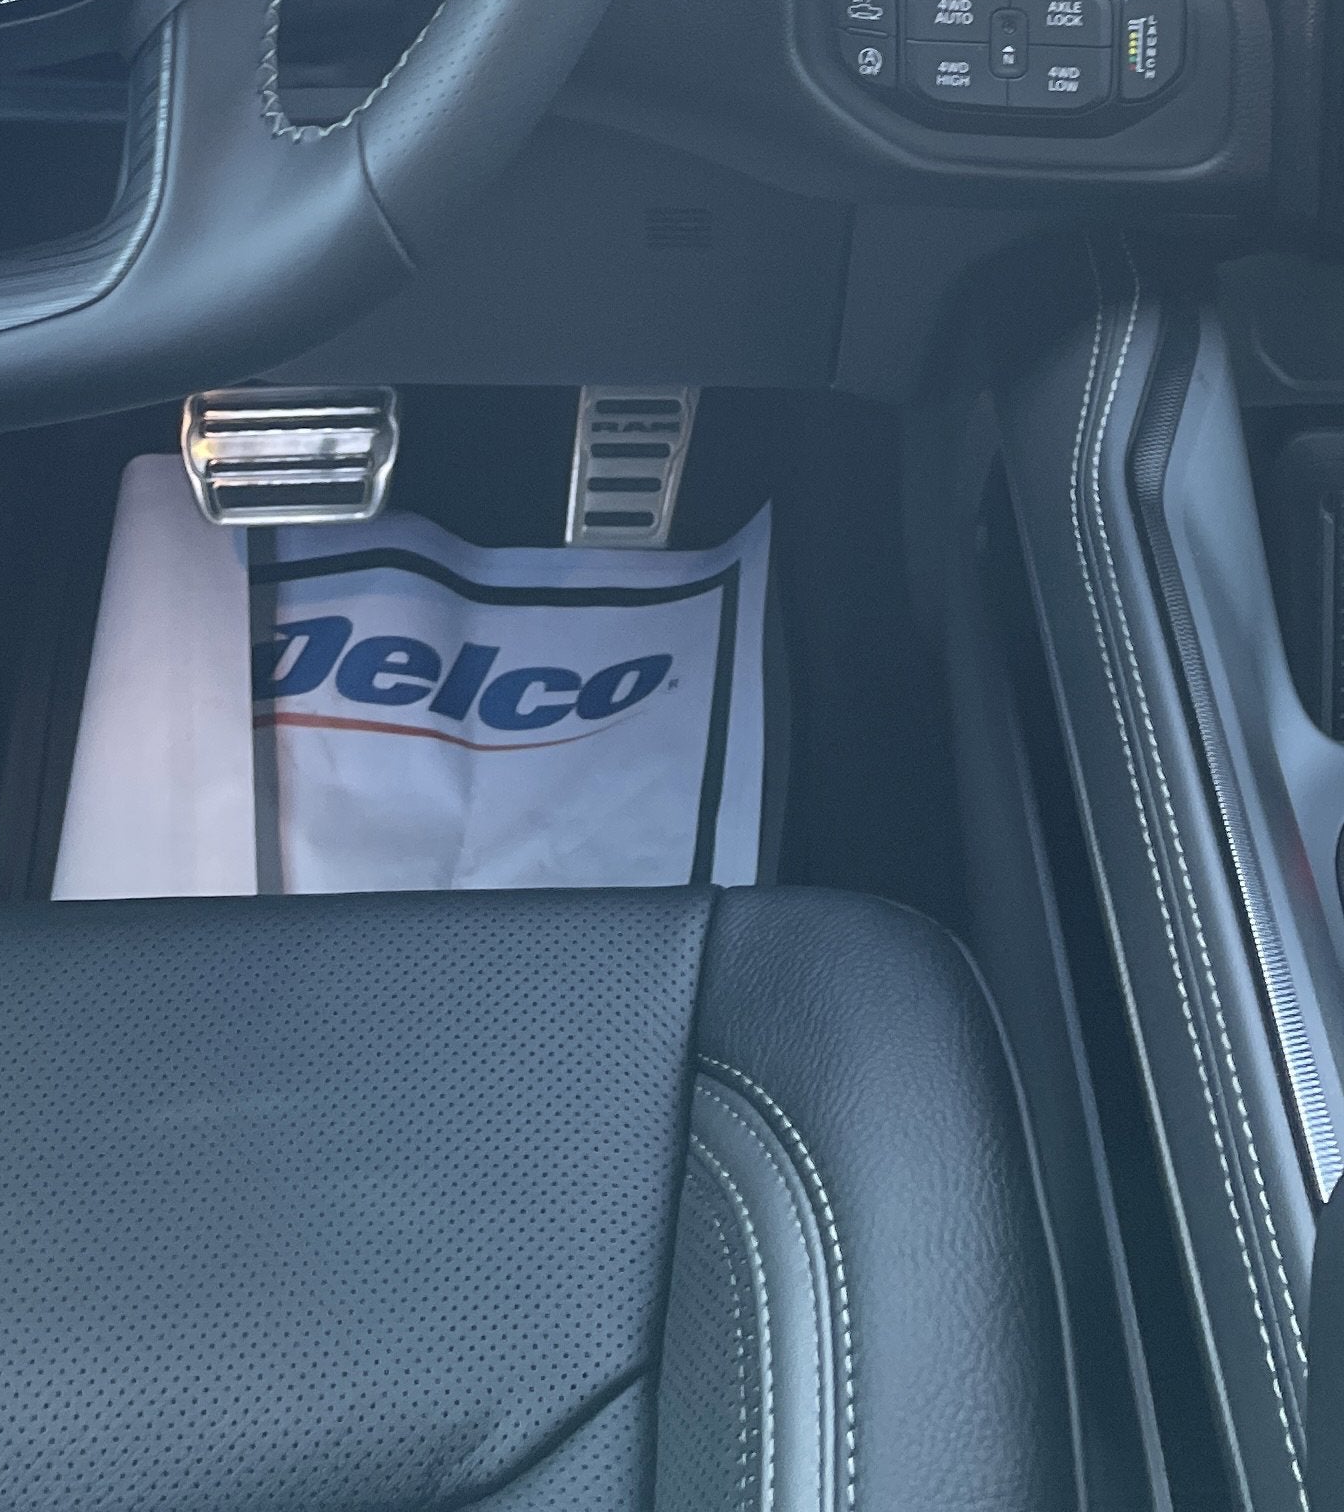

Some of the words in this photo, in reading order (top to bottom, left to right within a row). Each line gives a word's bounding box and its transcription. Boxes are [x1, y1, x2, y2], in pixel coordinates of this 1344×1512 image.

[1047, 0, 1082, 14] AXLE
[933, 12, 974, 26] AUTO
[1045, 14, 1084, 27] LOCK
[937, 61, 970, 75] 4WD
[1047, 66, 1081, 79] 4WD
[935, 73, 972, 87] HIGH
[1047, 79, 1080, 92] LOW
